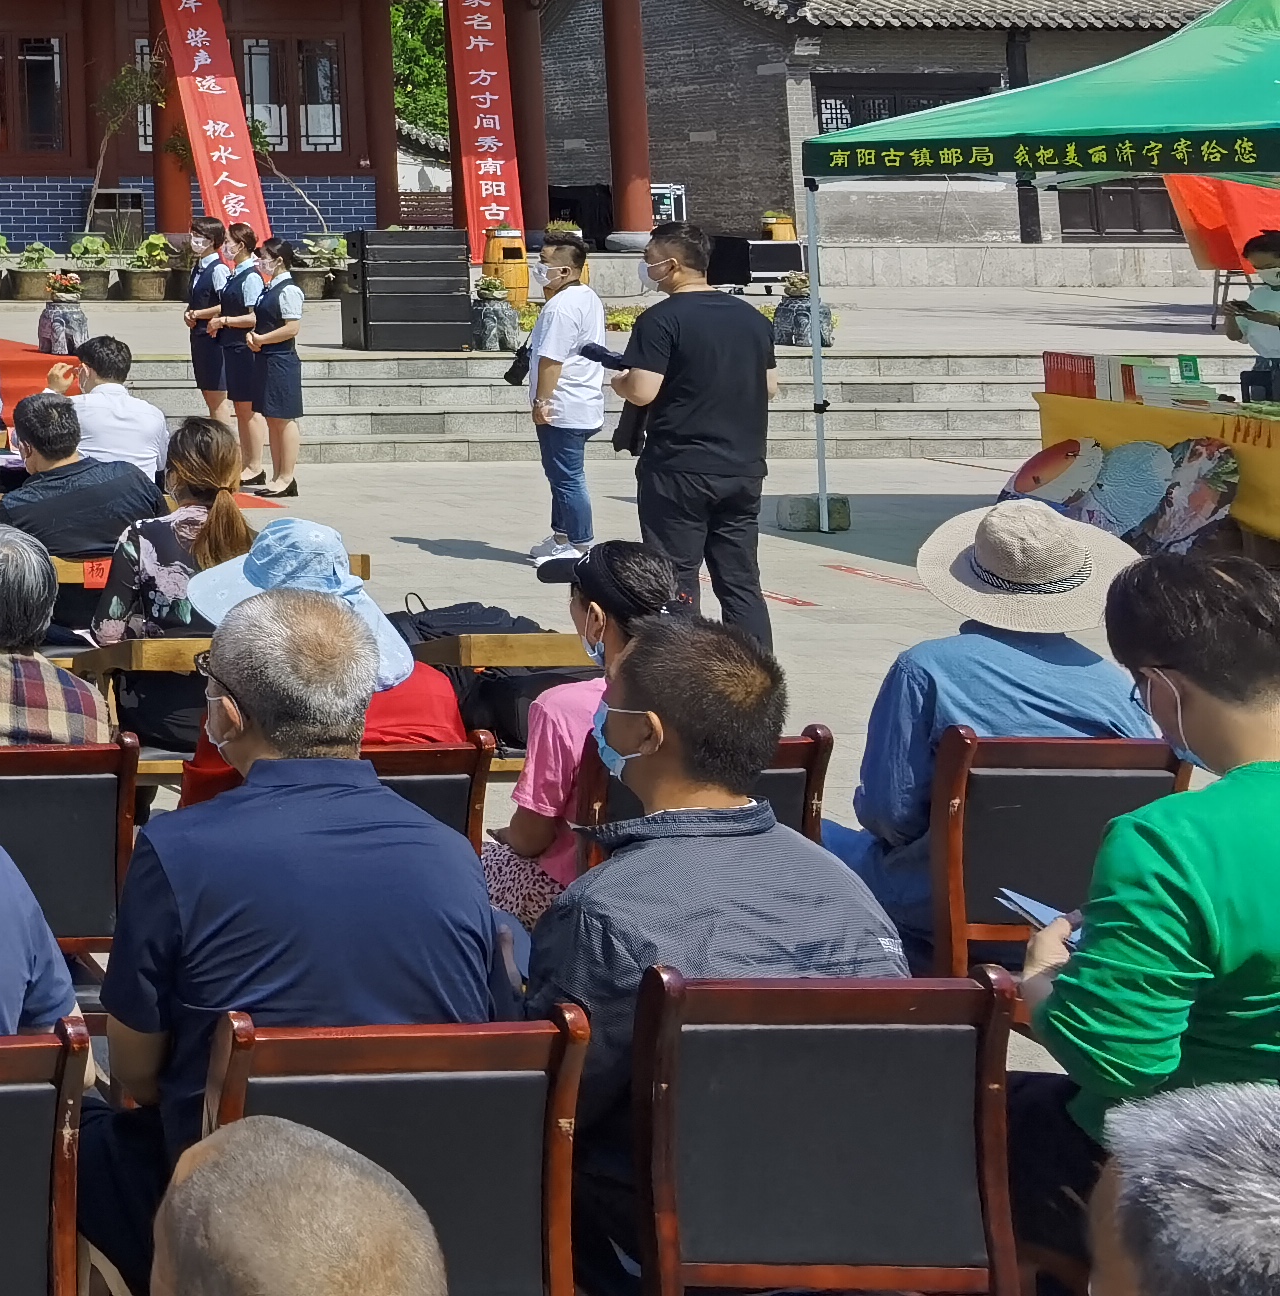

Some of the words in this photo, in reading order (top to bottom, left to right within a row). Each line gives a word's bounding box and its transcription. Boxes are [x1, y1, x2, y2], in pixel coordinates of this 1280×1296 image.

[202, 120, 251, 223] 枕水人家
[829, 145, 994, 168] 南阳古镇邮局
[1013, 137, 1258, 168] 我把美丽济宁寄给您
